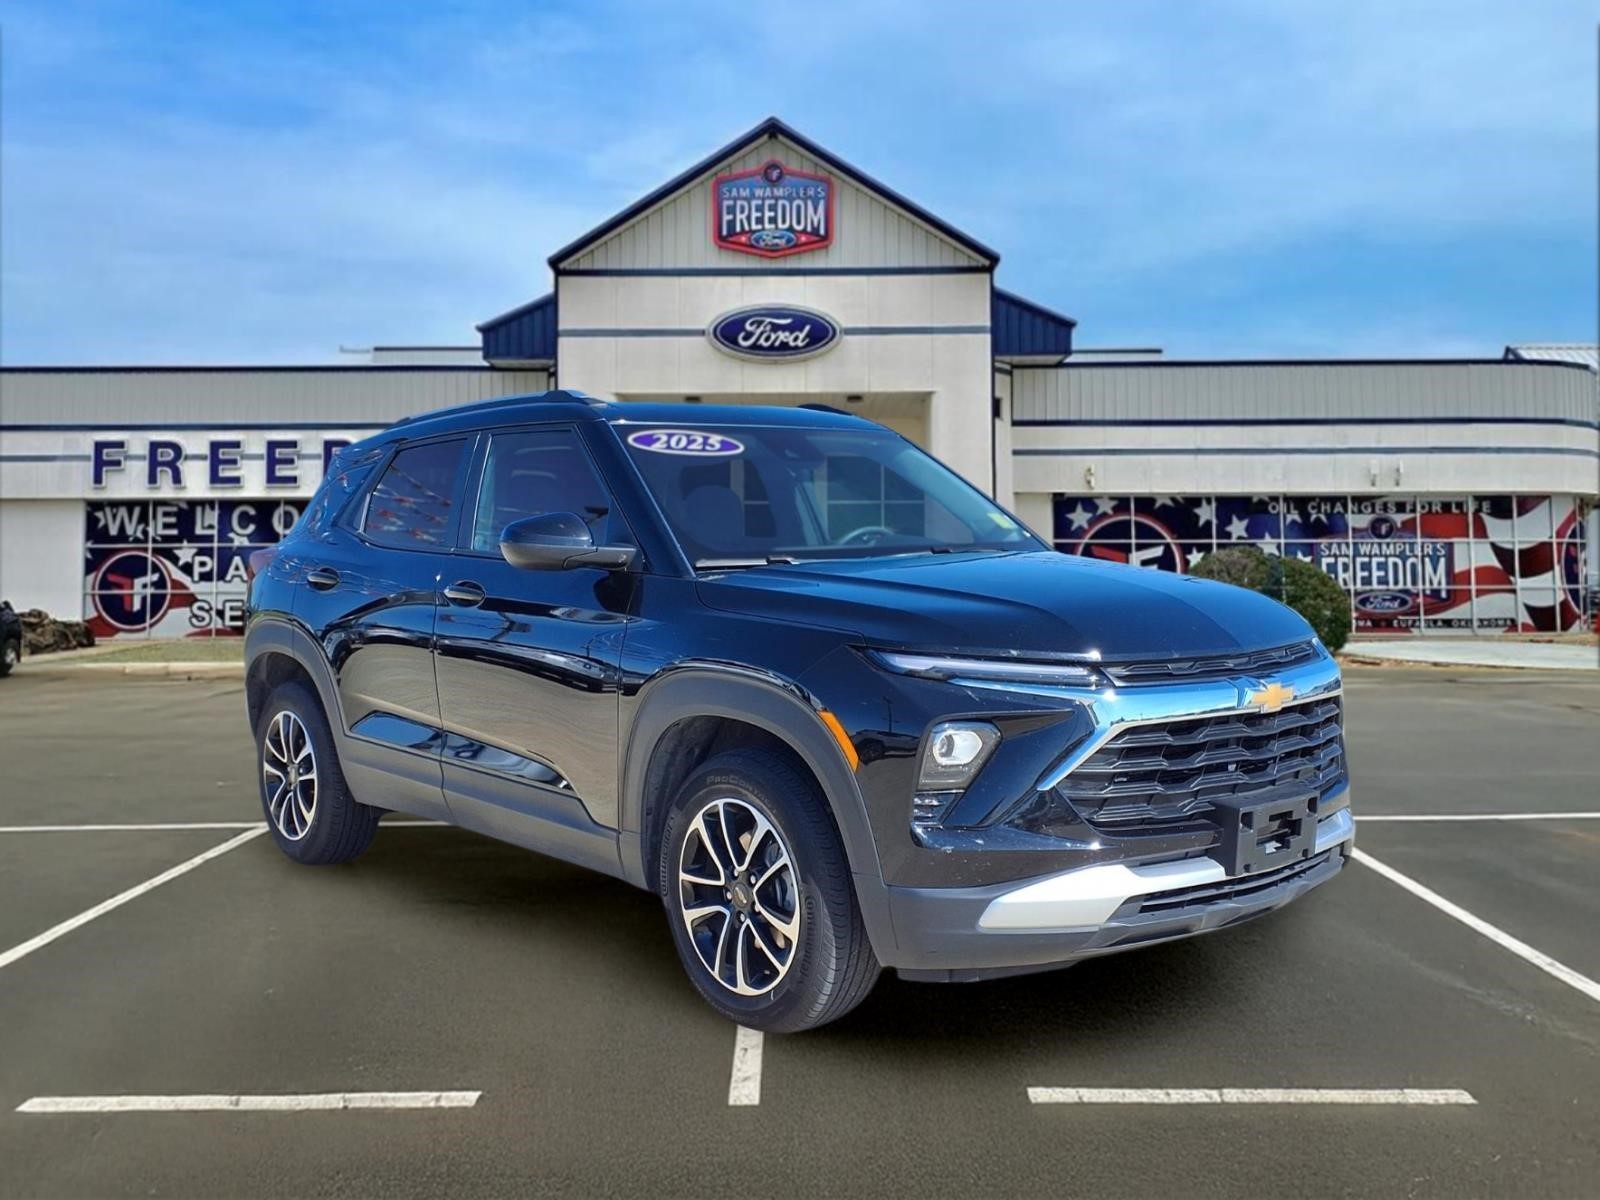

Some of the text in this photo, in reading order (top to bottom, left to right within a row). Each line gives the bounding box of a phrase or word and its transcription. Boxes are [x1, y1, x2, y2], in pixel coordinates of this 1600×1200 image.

[722, 186, 826, 199] SAM WAMPLER'S
[721, 199, 826, 237] FREEDOM
[737, 316, 812, 348] Ford
[650, 433, 722, 451] 2025
[104, 503, 301, 537] WELCO
[1268, 500, 1492, 514] OIL CHANGES FOR LIFE
[192, 554, 248, 583] PA
[1320, 556, 1448, 599] FREEDOM
[190, 600, 244, 628] SE
[1365, 595, 1401, 609] Ford
